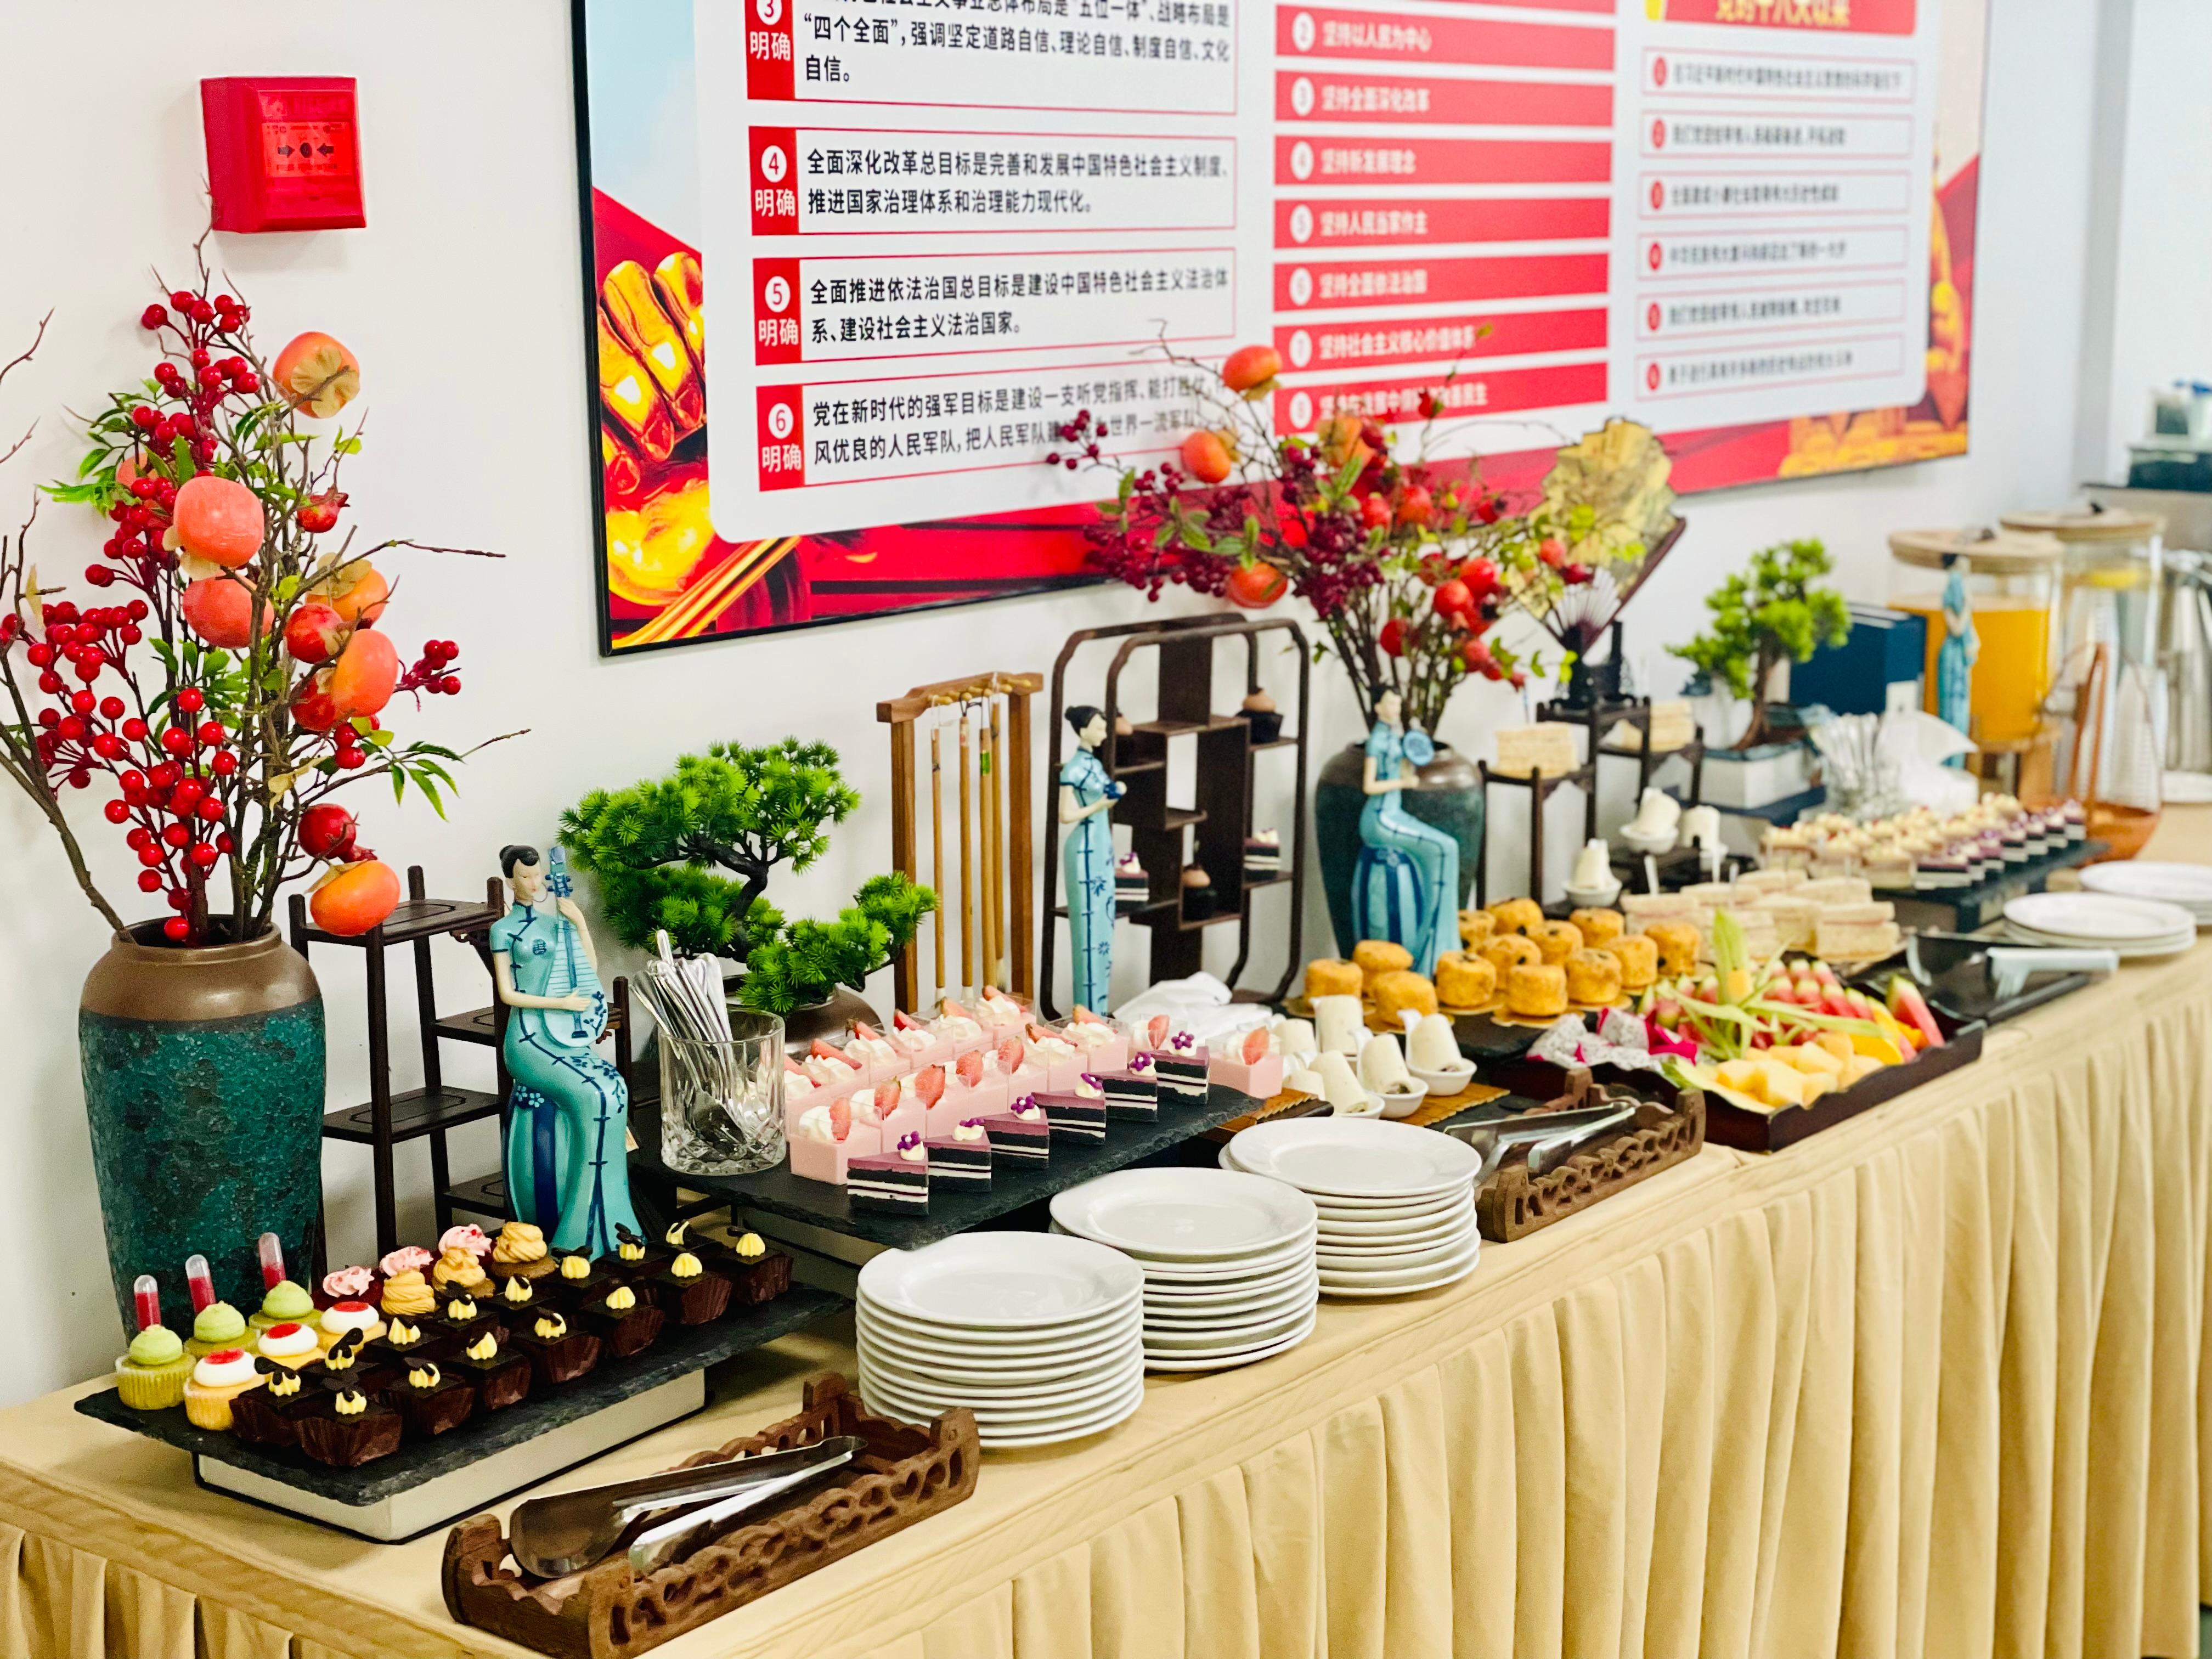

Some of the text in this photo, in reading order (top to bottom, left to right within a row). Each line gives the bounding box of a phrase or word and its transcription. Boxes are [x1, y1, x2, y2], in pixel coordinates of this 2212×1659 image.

[749, 31, 791, 61] 明确
[805, 55, 850, 82] 自信。
[755, 188, 795, 217] 明确
[808, 188, 1091, 215] 推进国家治理体系和治理能力现代化。
[811, 268, 1228, 304] 全面推进依法治国总目标是建设中国特色社会主义法治体
[758, 317, 799, 347] 明确
[811, 311, 1019, 343] 系、建设社会主义法治国家。
[761, 442, 802, 473] 明确
